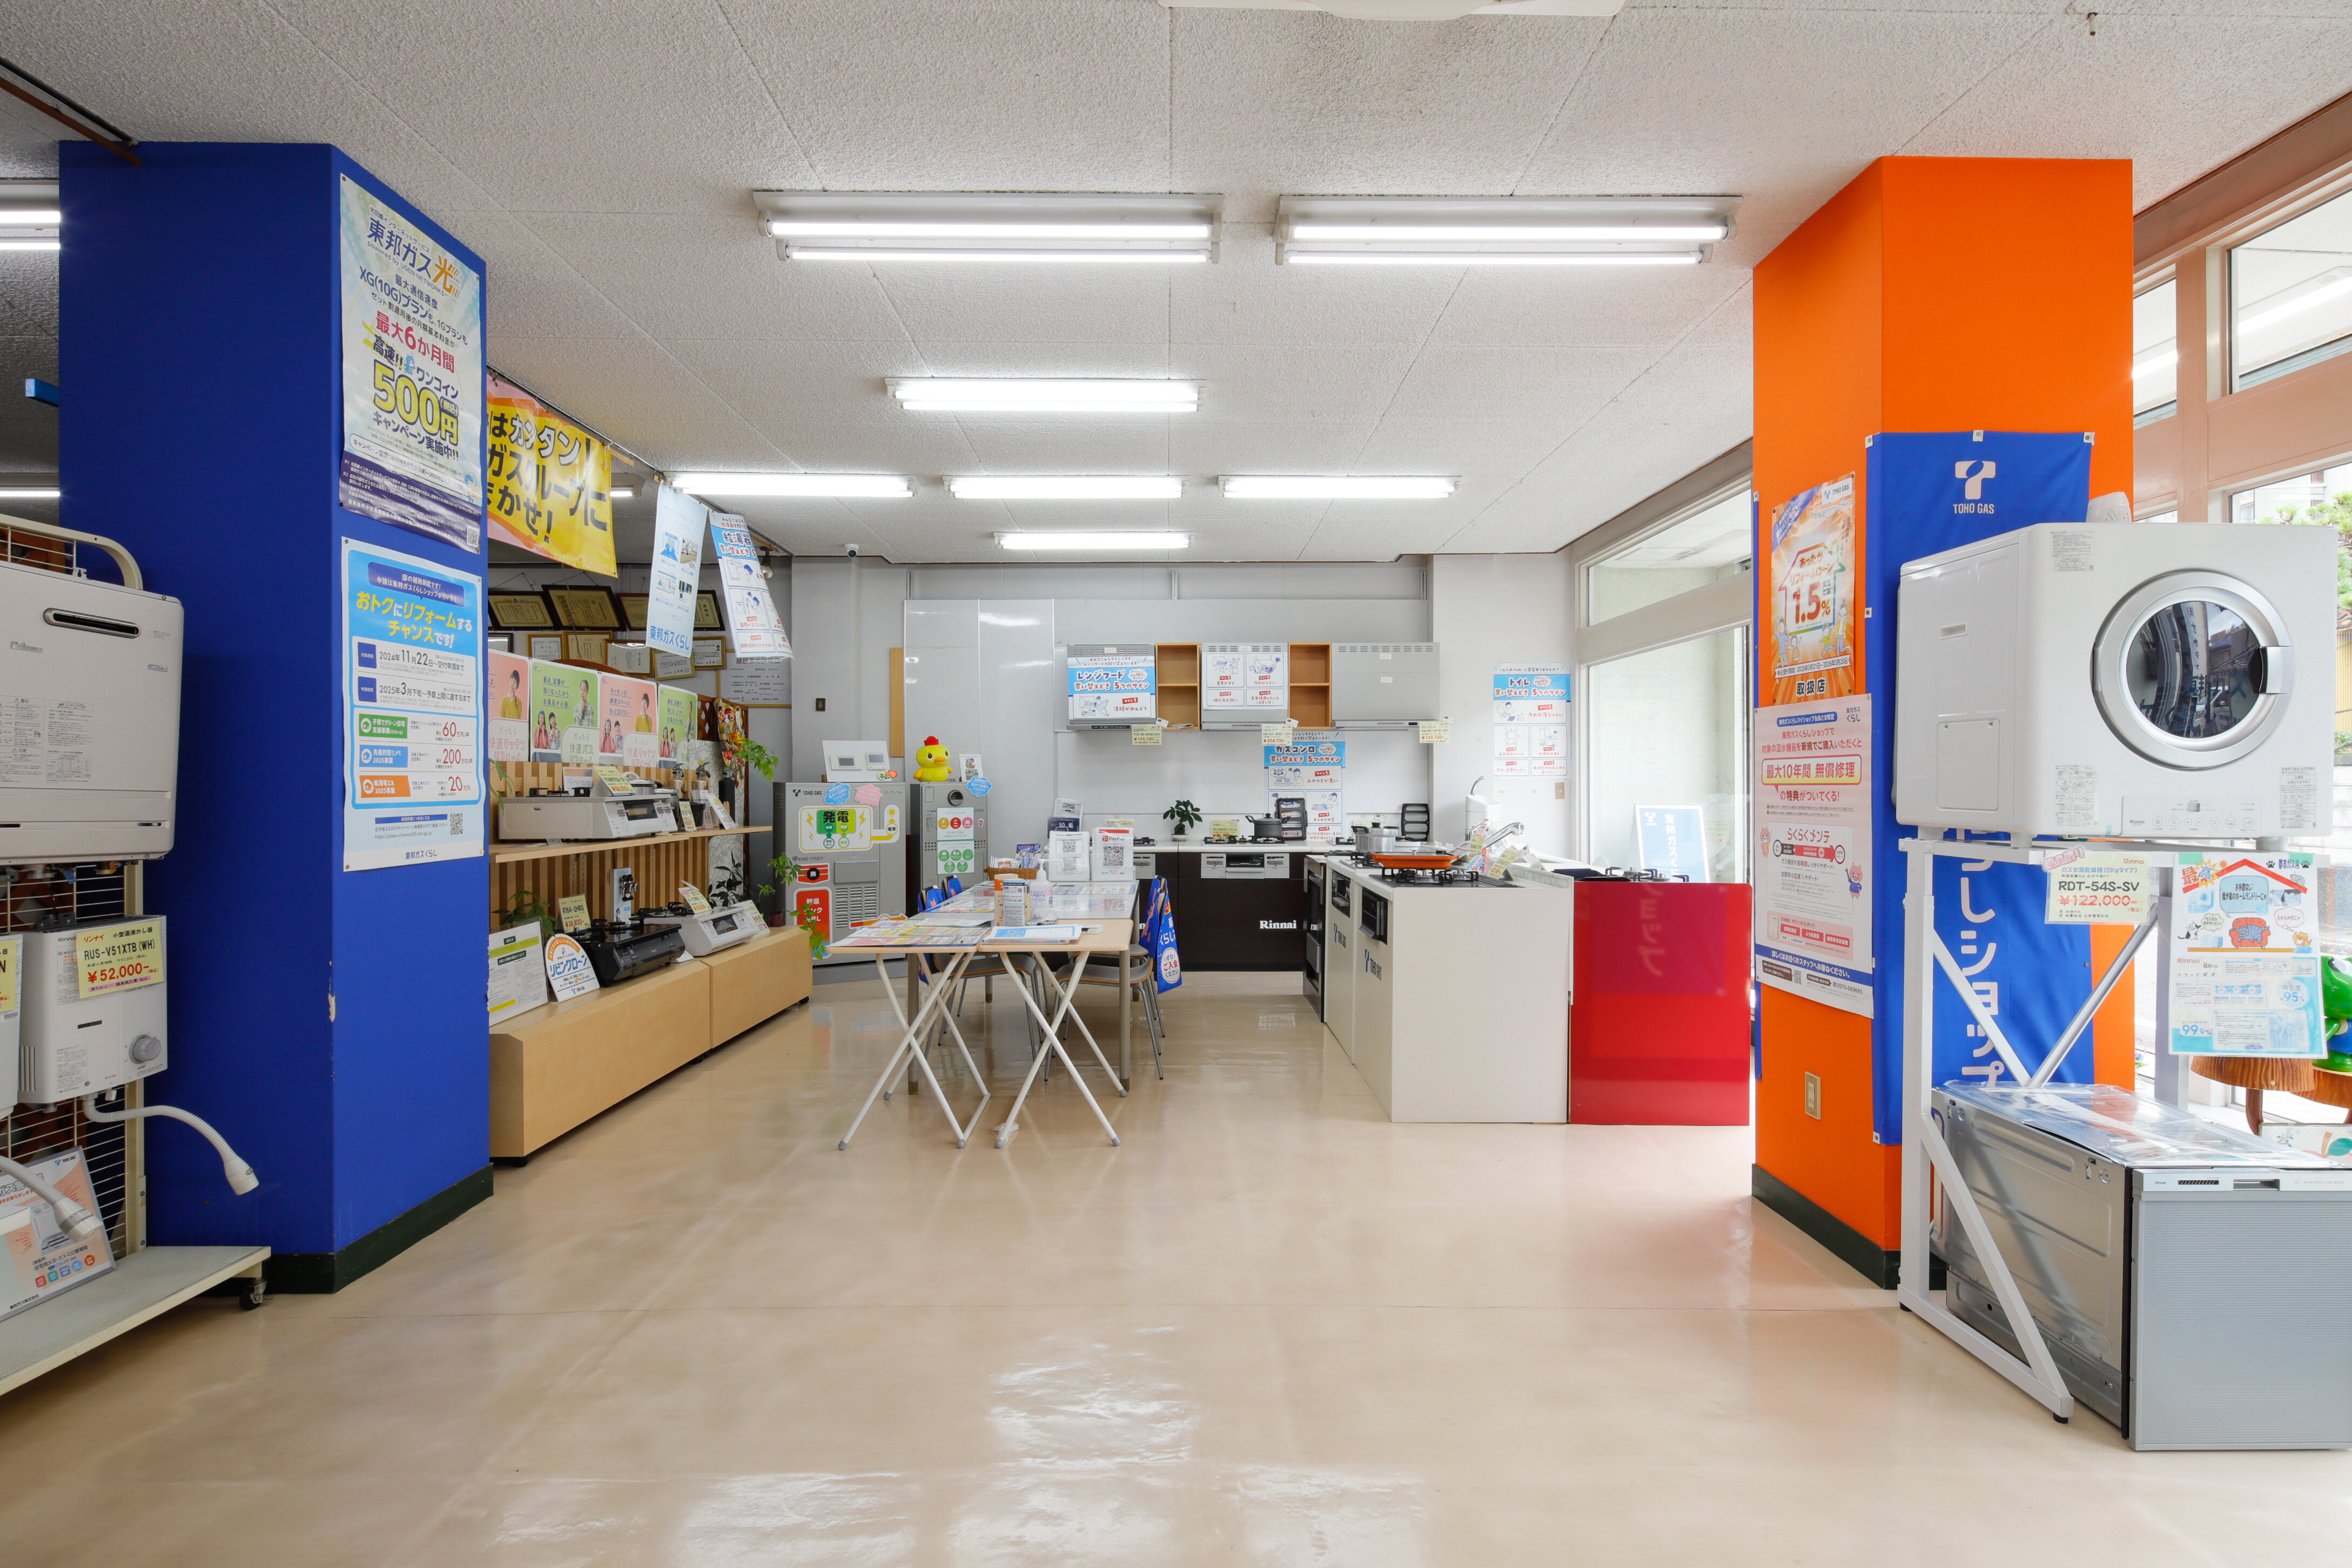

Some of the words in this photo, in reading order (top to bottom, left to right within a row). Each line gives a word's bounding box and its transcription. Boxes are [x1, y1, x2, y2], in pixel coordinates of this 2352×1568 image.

[367, 243, 391, 260] powered
[400, 263, 415, 277] USEN
[395, 274, 438, 311] 最大通信速度
[377, 311, 454, 373] 最大6か月間
[416, 367, 458, 398] ワンコイン
[374, 359, 458, 446] 500円
[373, 411, 458, 462] キャンペーン実施中!!
[1953, 503, 1975, 514] TOHO
[1977, 503, 1994, 514] GAS
[723, 531, 751, 547] 給湯器
[719, 543, 750, 557] 買い替えどき
[1799, 552, 1823, 568] あったか
[1789, 563, 1834, 585] リフォームローン
[357, 591, 472, 632] おトクにリフォームする
[388, 621, 454, 648] チャンスです!
[650, 625, 690, 651] 東邦ガスくらし
[1077, 670, 1126, 682] レンジフード
[1509, 678, 1530, 687] トイレ
[1073, 683, 1112, 692] 買い替えどき
[1114, 682, 1150, 691] 5つのサイン
[1796, 677, 1826, 696] 取扱店
[1846, 714, 1861, 723] くらし
[1782, 727, 1835, 739] 東邦ガスくらしショップで
[488, 737, 526, 751] 快適キッチン
[569, 743, 594, 755] 快適バス
[1762, 738, 1863, 753] 対象の温水機器を新規でご購入いただくと
[1271, 756, 1305, 764] 買い替えどき
[1766, 763, 1811, 779] 最大10年間
[1815, 762, 1856, 778] 無償修理
[1780, 790, 1840, 802] の特典がついてくる!
[823, 811, 849, 823] 発電
[1787, 827, 1830, 844] らくらくメンテ
[405, 849, 437, 859] 東邦ガスくらし
[2043, 846, 2085, 870] 現品限り
[2278, 859, 2300, 869] 都市ガス用
[2182, 864, 2214, 887] 最高
[2059, 881, 2139, 891] RDT-54S-SV
[1260, 920, 1297, 929] Rinnai
[84, 934, 104, 943] リンナイ
[550, 955, 587, 977] リビングローン
[1164, 960, 1178, 971] ご入会
[1771, 950, 1850, 978] 詳しくはお近くのスタッフへお尋ねください。
[1165, 970, 1179, 978] ください
[2182, 1025, 2212, 1035] 99.9%
